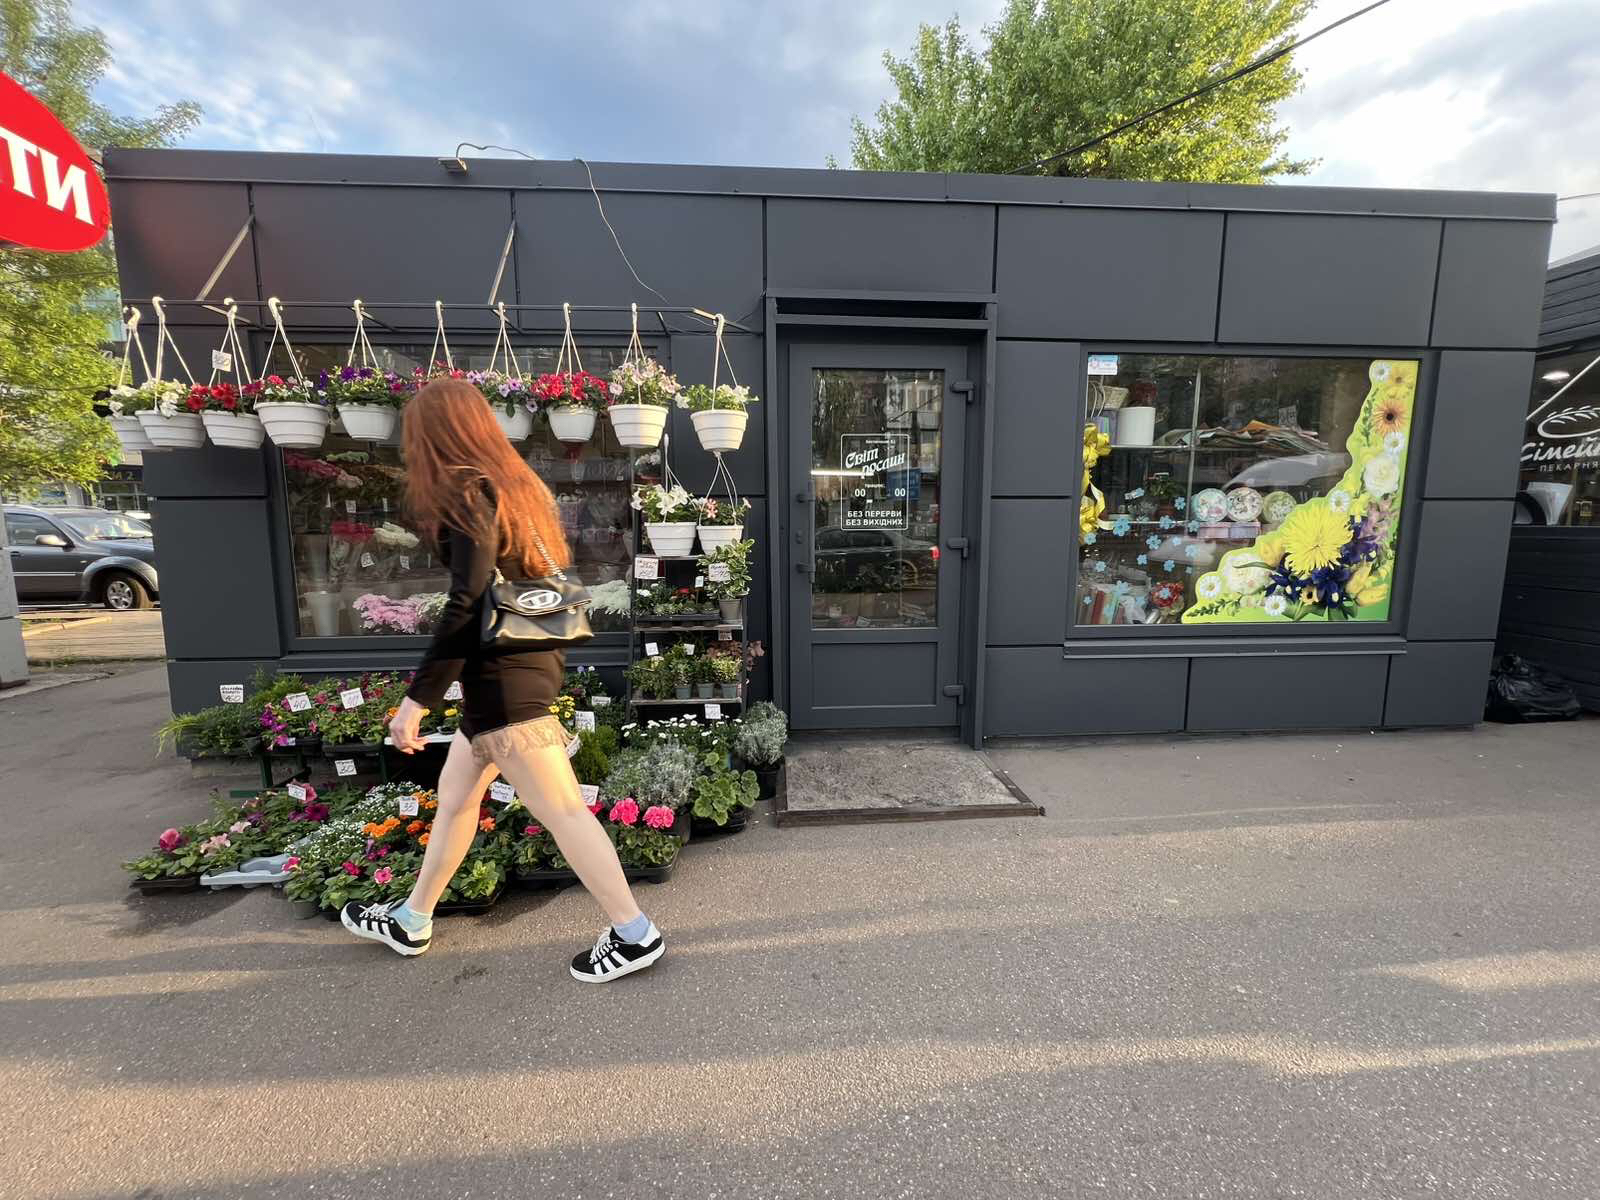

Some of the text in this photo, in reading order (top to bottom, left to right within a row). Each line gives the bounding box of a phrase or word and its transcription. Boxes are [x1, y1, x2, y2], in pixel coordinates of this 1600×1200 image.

[845, 448, 879, 469] Світ
[861, 452, 905, 479] рослин
[1540, 461, 1598, 472] ПЕКАРНЯ
[847, 510, 902, 518] БЕЗ ПЕРЕРВИ
